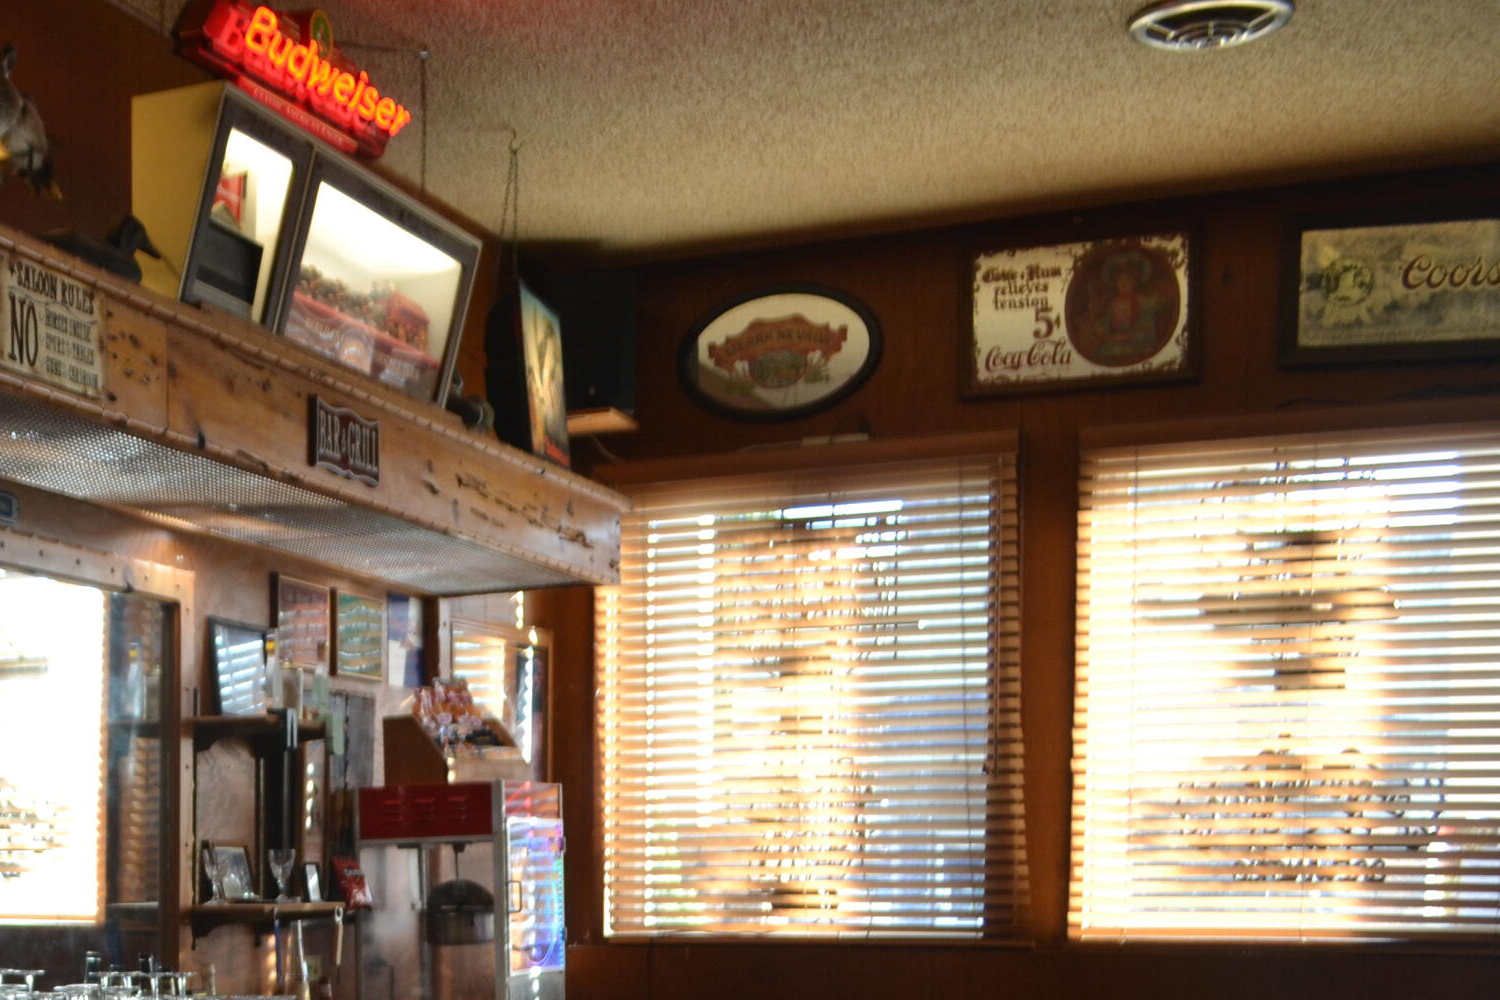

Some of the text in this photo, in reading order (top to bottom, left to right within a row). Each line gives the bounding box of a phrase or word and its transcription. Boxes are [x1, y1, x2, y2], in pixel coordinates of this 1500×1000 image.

[245, 6, 411, 136] Budweiser
[17, 261, 95, 315] SALOON RULES
[8, 291, 38, 367] NO
[319, 408, 342, 461] BAR
[348, 420, 379, 474] GRILL
